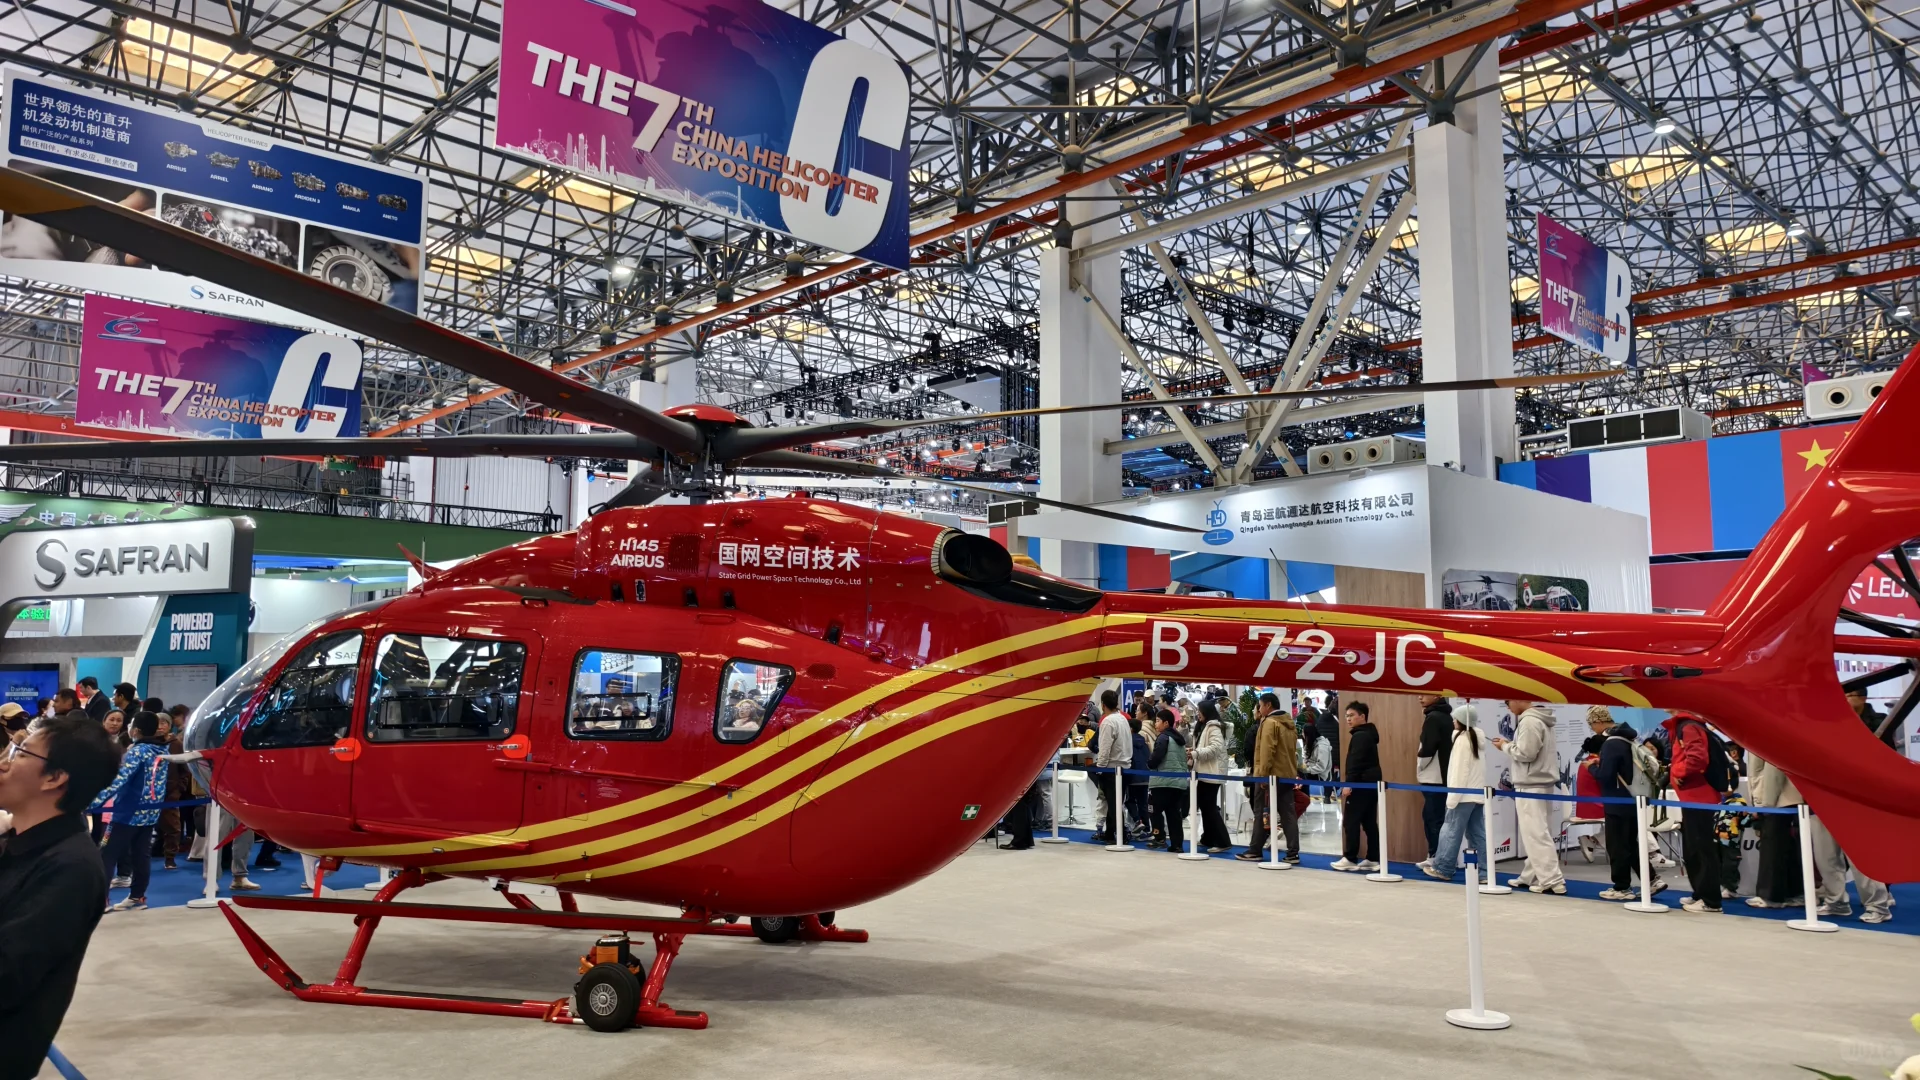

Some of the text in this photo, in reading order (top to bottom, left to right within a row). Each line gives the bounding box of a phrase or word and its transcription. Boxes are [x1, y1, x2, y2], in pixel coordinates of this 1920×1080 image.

[527, 41, 636, 116] THE
[23, 92, 132, 129] 世界领先的直升
[21, 124, 94, 147] 提供广泛的产品系列
[22, 108, 131, 144] 机发动机制造商
[207, 128, 268, 148] HELICOPTER ENGINES
[779, 38, 911, 255] C
[166, 163, 187, 173] ARRIUS
[672, 142, 810, 203] EXPOSITION
[676, 120, 880, 204] CHINA HELICOPTER
[210, 174, 229, 183] ARRIEL
[208, 291, 265, 307] SAFRAN
[1546, 278, 1568, 307] THE
[1577, 305, 1627, 336] CHINA HELICOPTER
[1577, 318, 1609, 338] EXPOSITION
[94, 367, 164, 398] THE
[187, 405, 283, 428] EXPOSITION
[190, 394, 337, 423] CHINA HELICOPTER
[1239, 525, 1265, 534] Qingdao
[1316, 517, 1343, 525] Aviation
[1345, 513, 1383, 524] Technology
[1401, 509, 1415, 517] Ltd.
[1240, 493, 1414, 523] 青岛运航通达航空科技有限公司
[620, 539, 659, 552] H145
[719, 542, 860, 571] 国网空间技术
[73, 542, 209, 577] SAFRAN
[610, 554, 665, 568] AIRBUS
[738, 572, 751, 580] Grid
[773, 575, 793, 583] Space
[794, 576, 833, 585] Technology
[835, 578, 848, 586] Co.,
[171, 613, 214, 631] POWERED
[170, 632, 212, 651] BY TRUST
